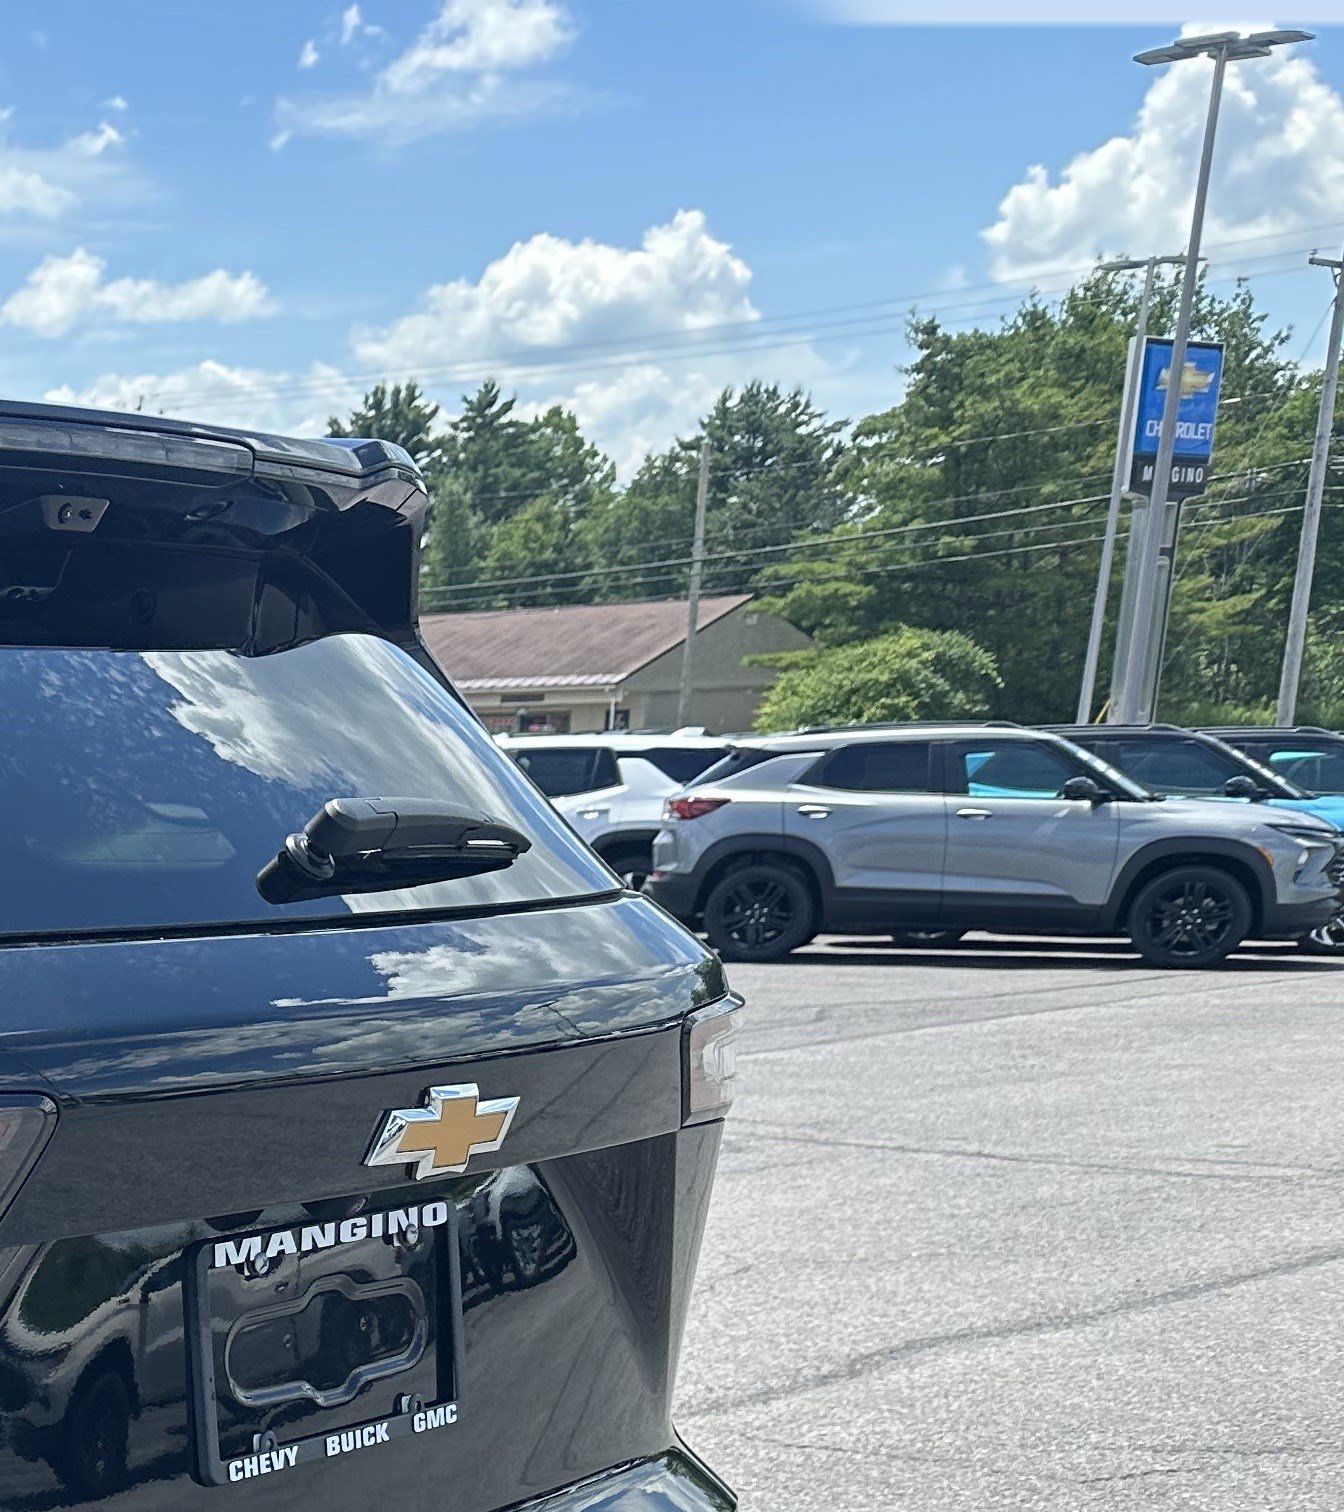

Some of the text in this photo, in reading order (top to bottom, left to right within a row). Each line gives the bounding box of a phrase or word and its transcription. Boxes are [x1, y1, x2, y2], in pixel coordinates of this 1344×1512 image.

[1145, 419, 1212, 440] CHROLET
[1142, 465, 1204, 483] MGINO
[214, 1202, 448, 1268] MANGINO
[228, 1404, 458, 1483] CHEVY BUICK GMC
